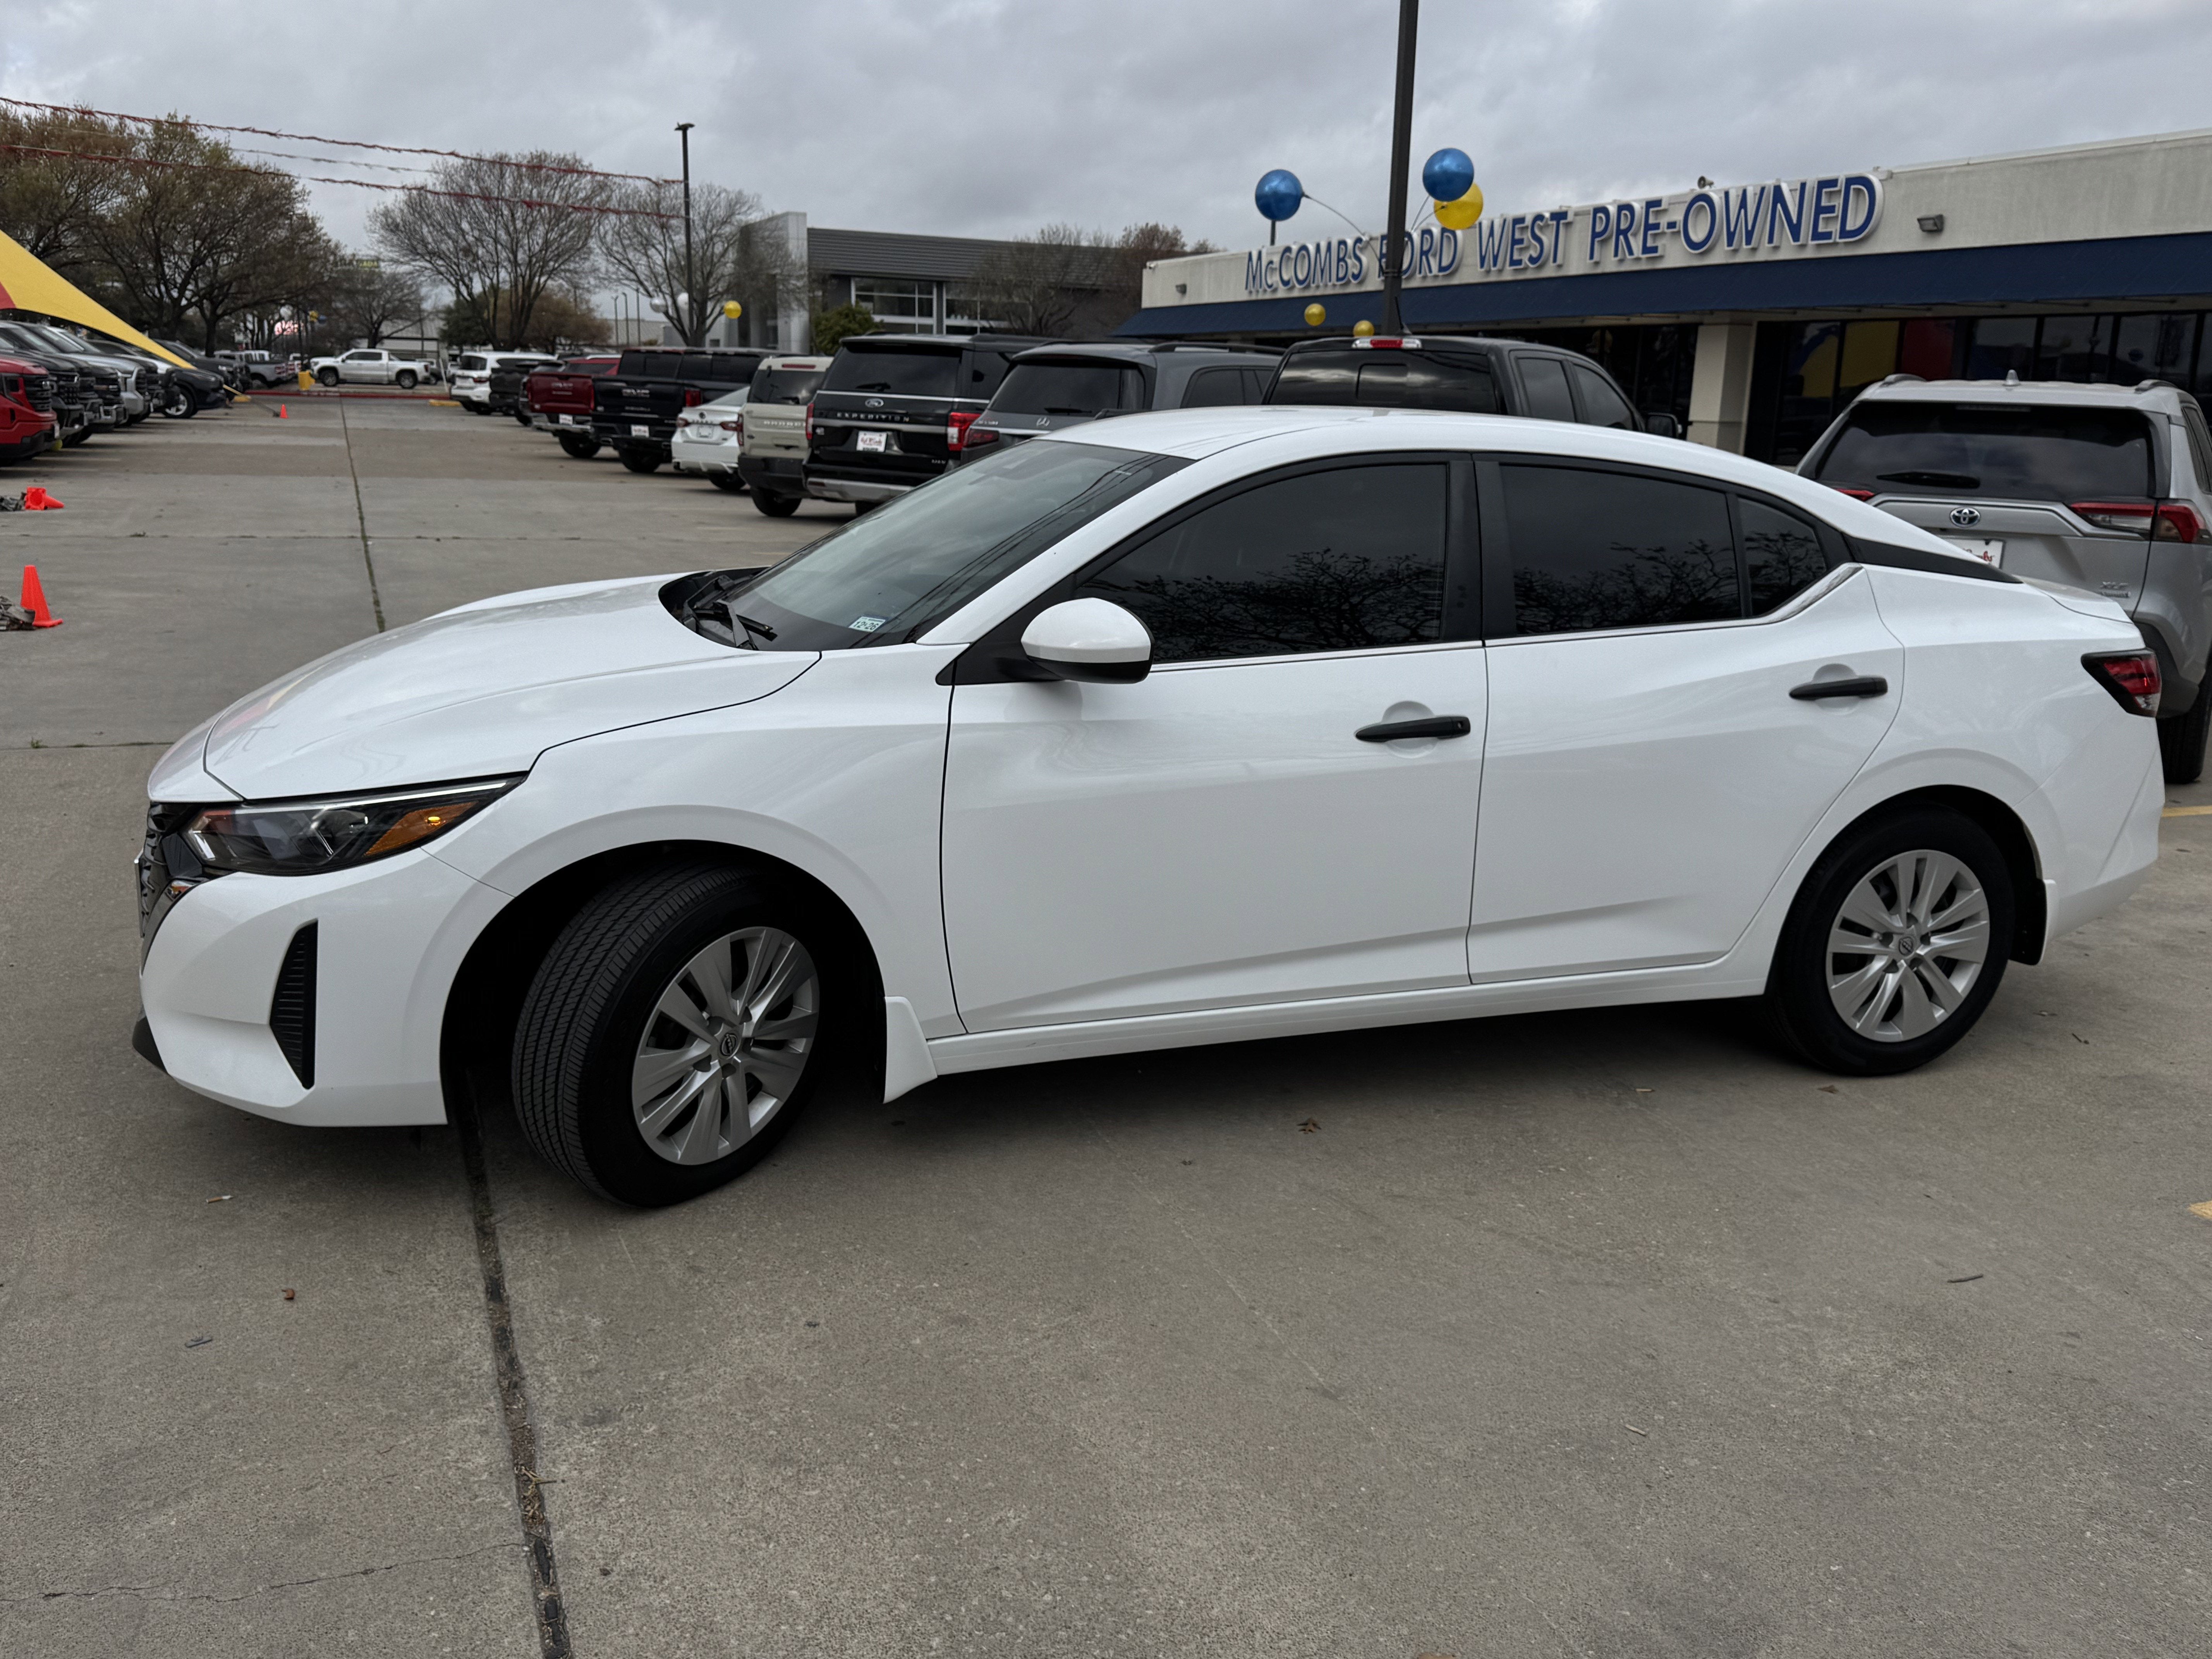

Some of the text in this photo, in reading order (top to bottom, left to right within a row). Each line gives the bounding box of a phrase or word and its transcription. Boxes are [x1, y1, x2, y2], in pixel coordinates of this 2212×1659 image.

[1245, 237, 1363, 290] McCOMBS
[1479, 211, 1568, 270] WEST
[1588, 176, 1876, 261] PRE-OWNED
[836, 411, 910, 422] EXPEDITION
